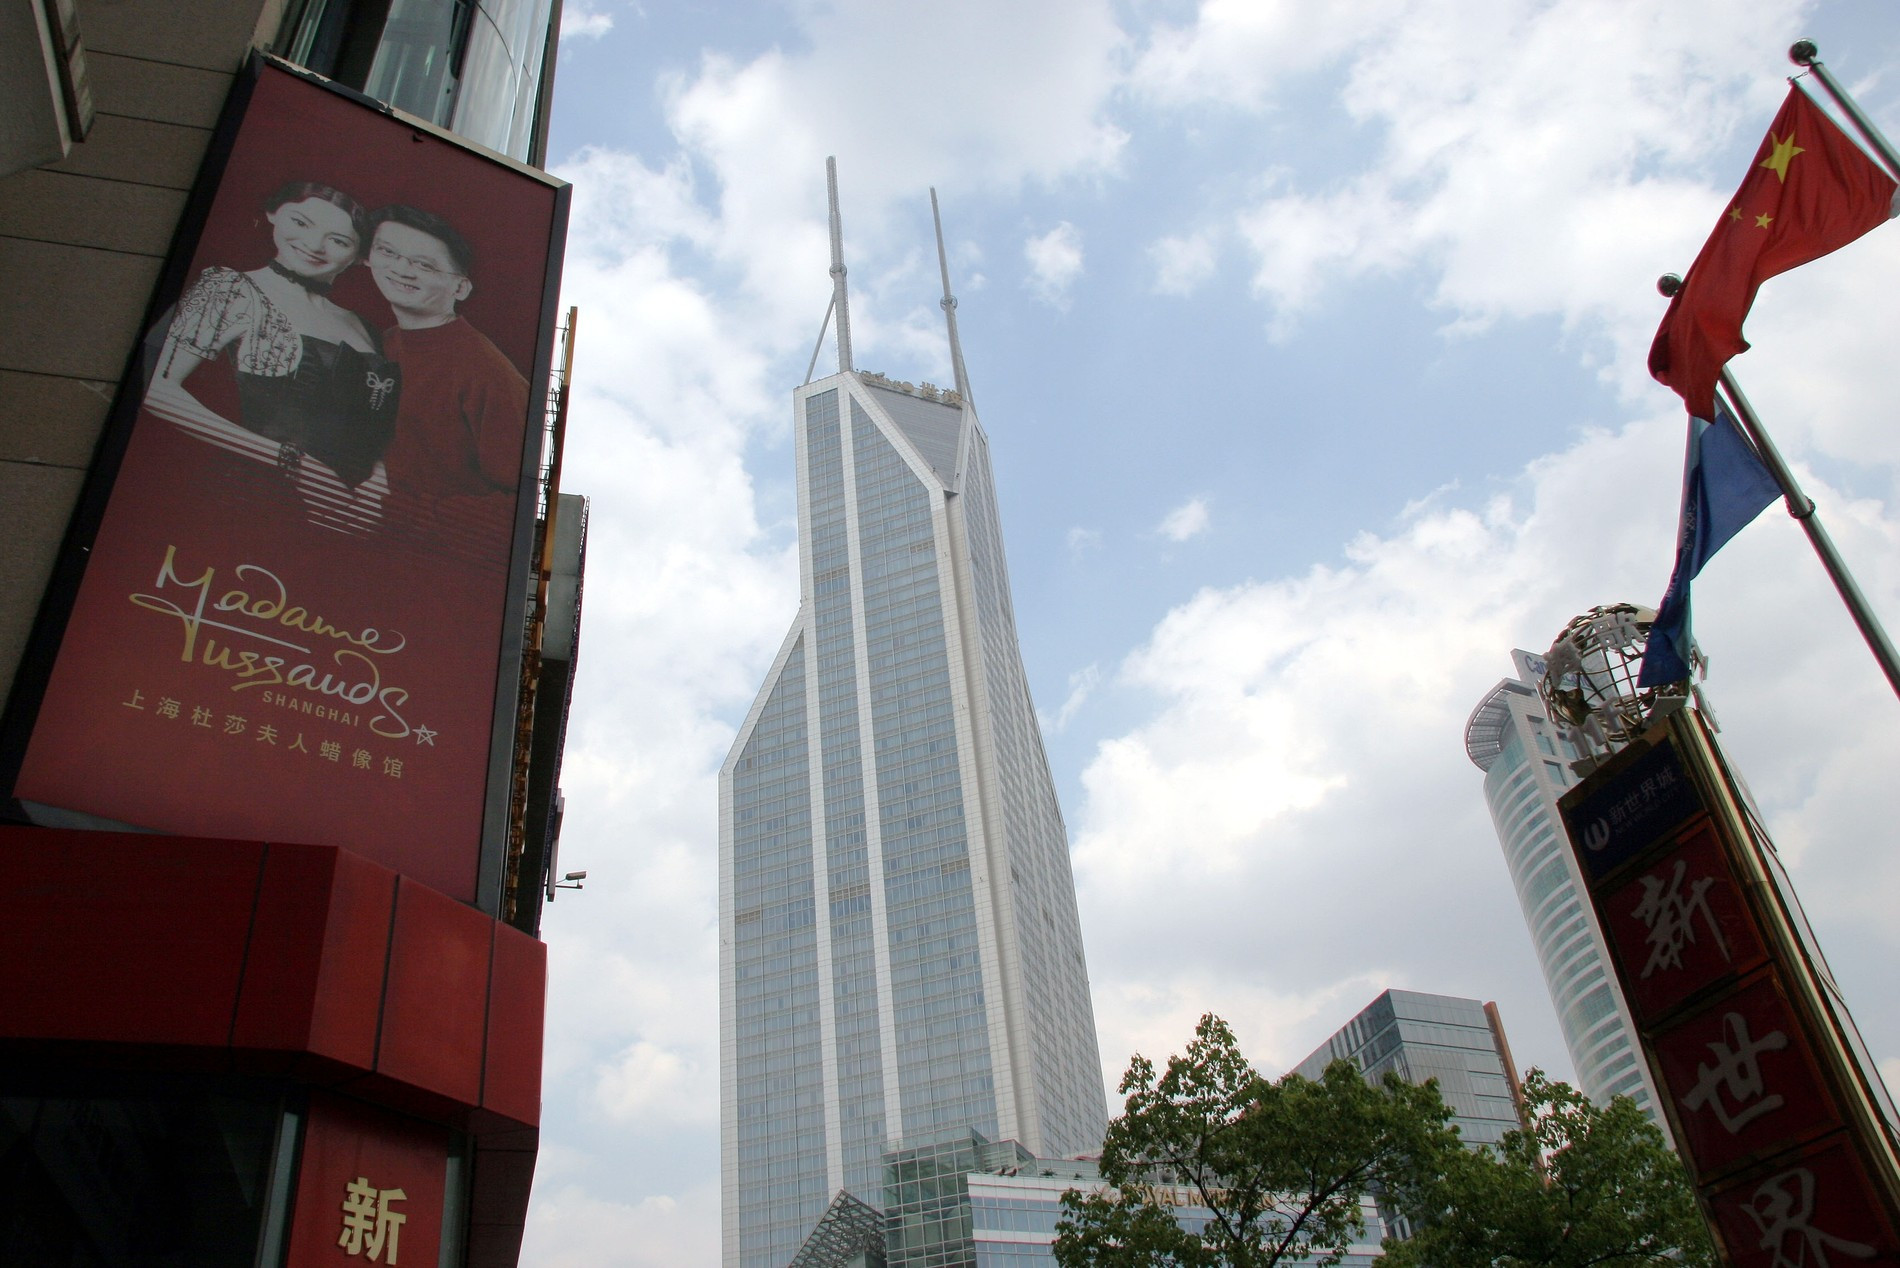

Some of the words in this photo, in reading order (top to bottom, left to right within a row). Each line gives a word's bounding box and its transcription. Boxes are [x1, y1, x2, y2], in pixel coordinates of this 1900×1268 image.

[155, 545, 406, 656] Madame
[122, 689, 404, 779] 上海杜莎夫人蜡像馆
[262, 690, 359, 727] SHANGHAI
[1608, 766, 1676, 825] 新世界城
[338, 1176, 407, 1266] 新
